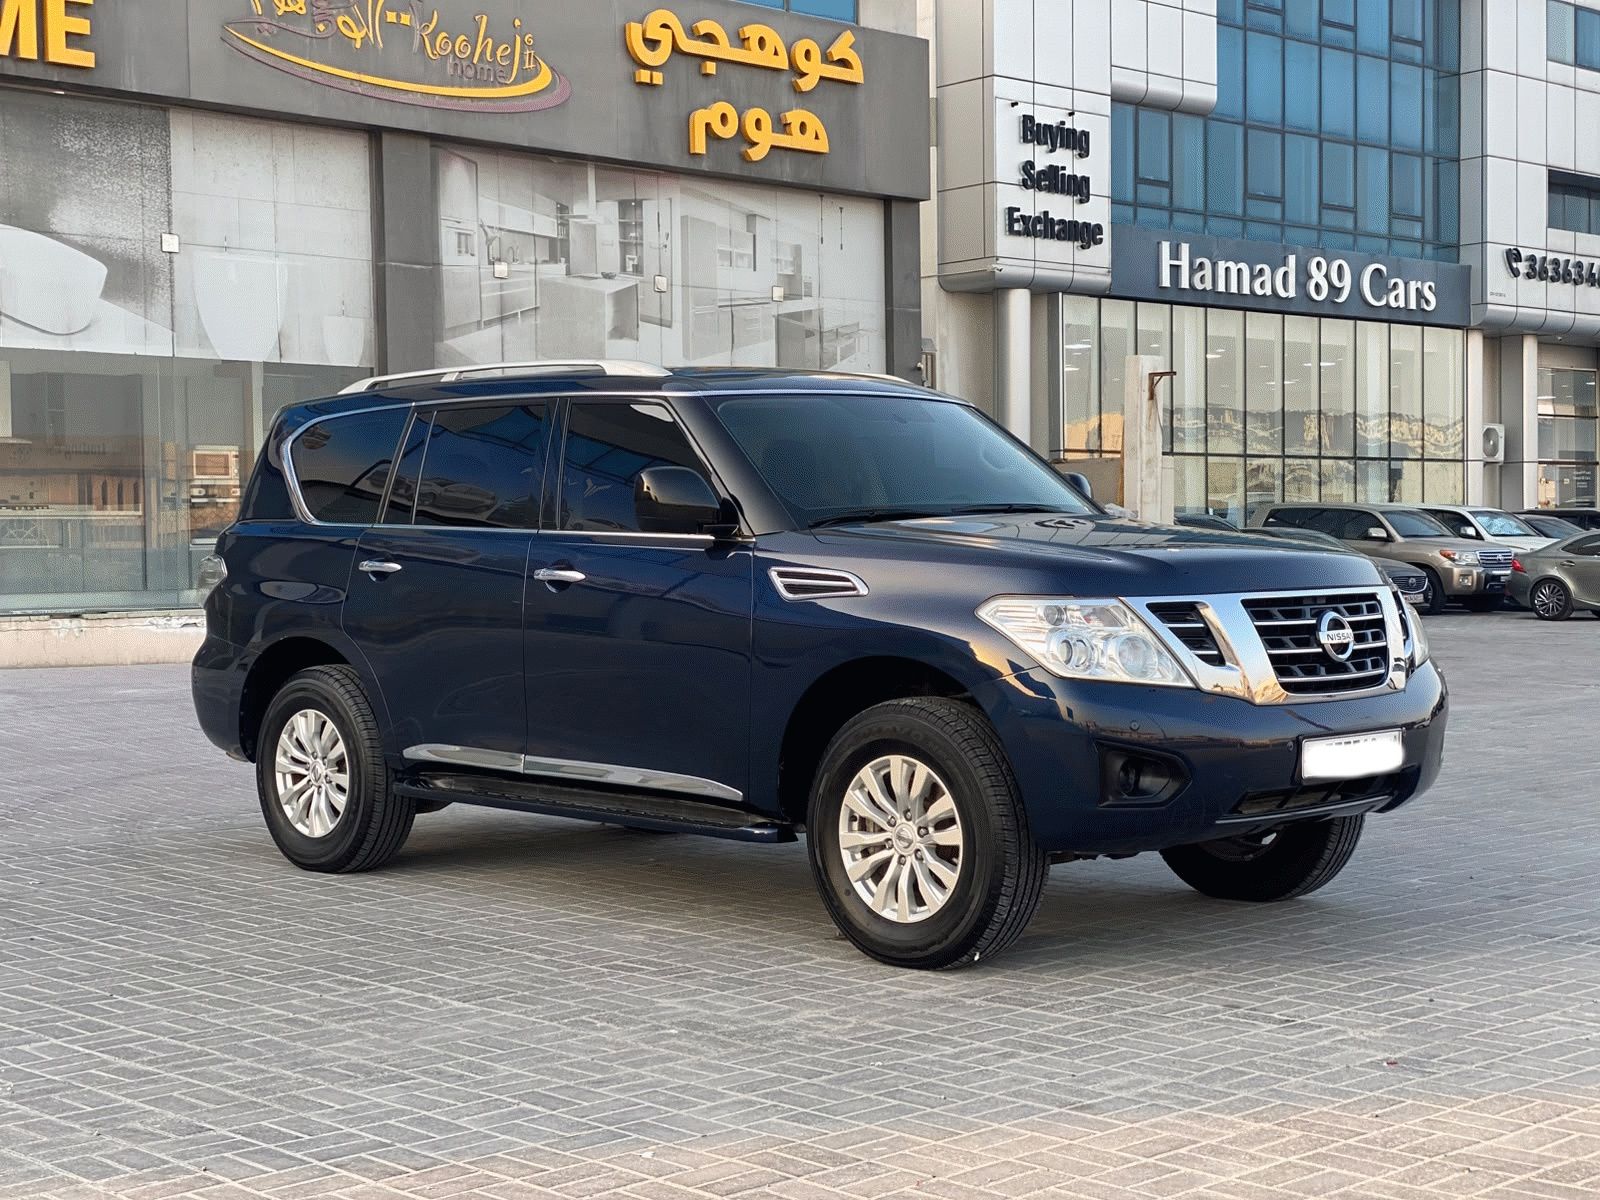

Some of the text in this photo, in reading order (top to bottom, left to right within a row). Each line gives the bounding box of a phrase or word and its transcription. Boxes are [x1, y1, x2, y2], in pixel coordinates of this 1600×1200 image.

[449, 54, 511, 84] home
[625, 9, 864, 92] كوهجي
[689, 101, 829, 161] هوم
[1020, 114, 1090, 158] Buying
[1020, 160, 1091, 204] Selling
[1006, 206, 1104, 250] Exchange
[1158, 240, 1437, 311] Hamad 89 Cars
[1523, 253, 1600, 288] 363634
